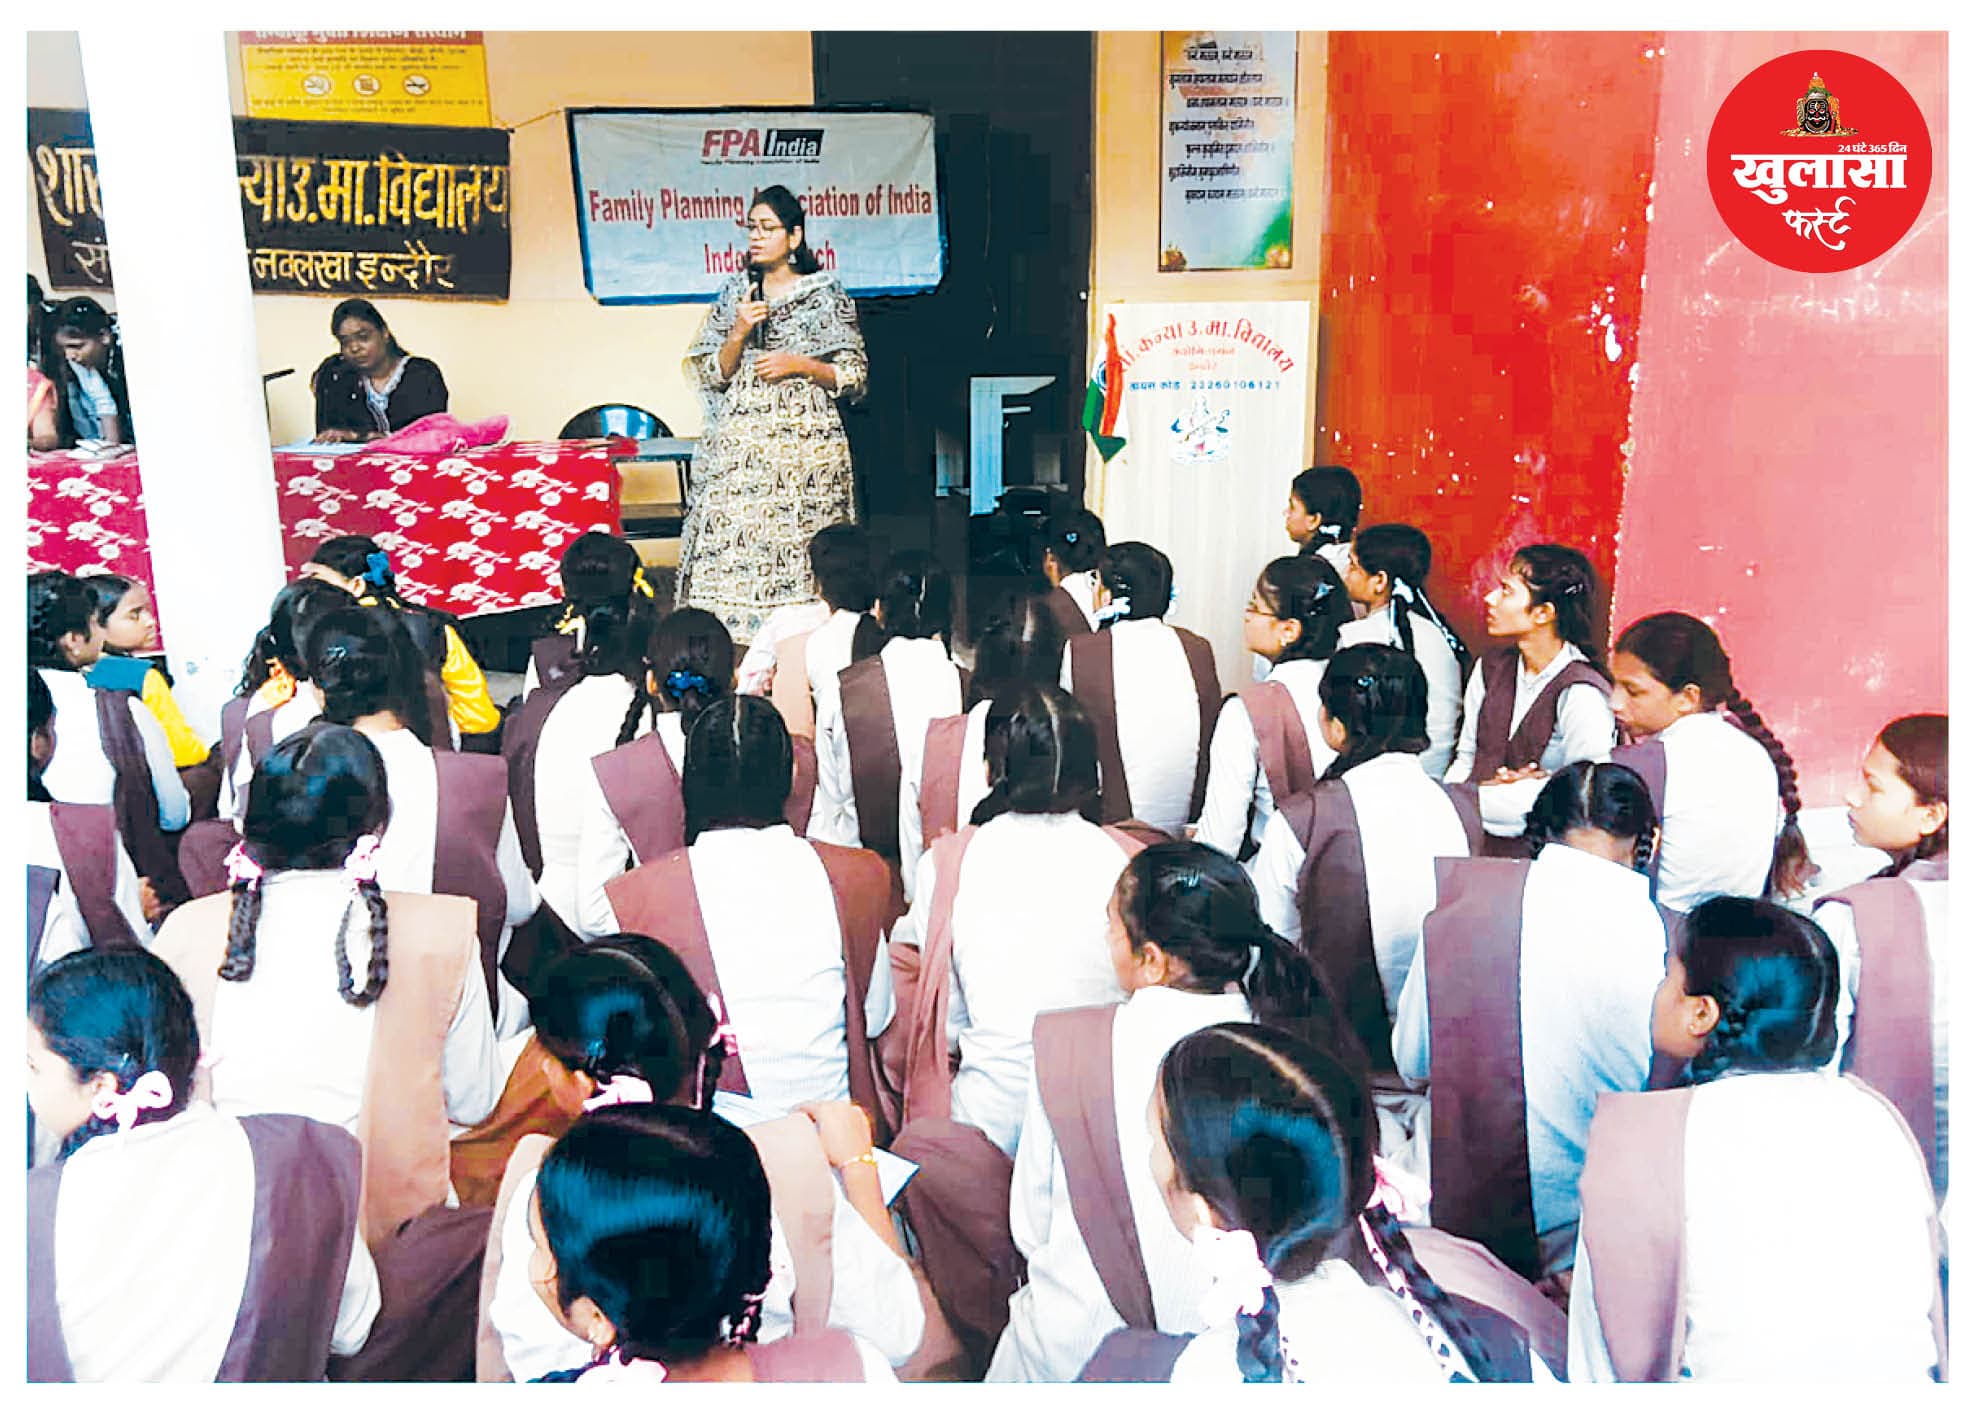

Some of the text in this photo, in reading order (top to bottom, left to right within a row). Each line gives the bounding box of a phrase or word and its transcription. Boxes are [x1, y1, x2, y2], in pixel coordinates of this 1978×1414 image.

[702, 128, 818, 157] FPA India
[588, 189, 654, 229] Family
[661, 187, 745, 228] Planning
[865, 183, 883, 216] of
[888, 183, 932, 216] India
[704, 242, 746, 274] Indo
